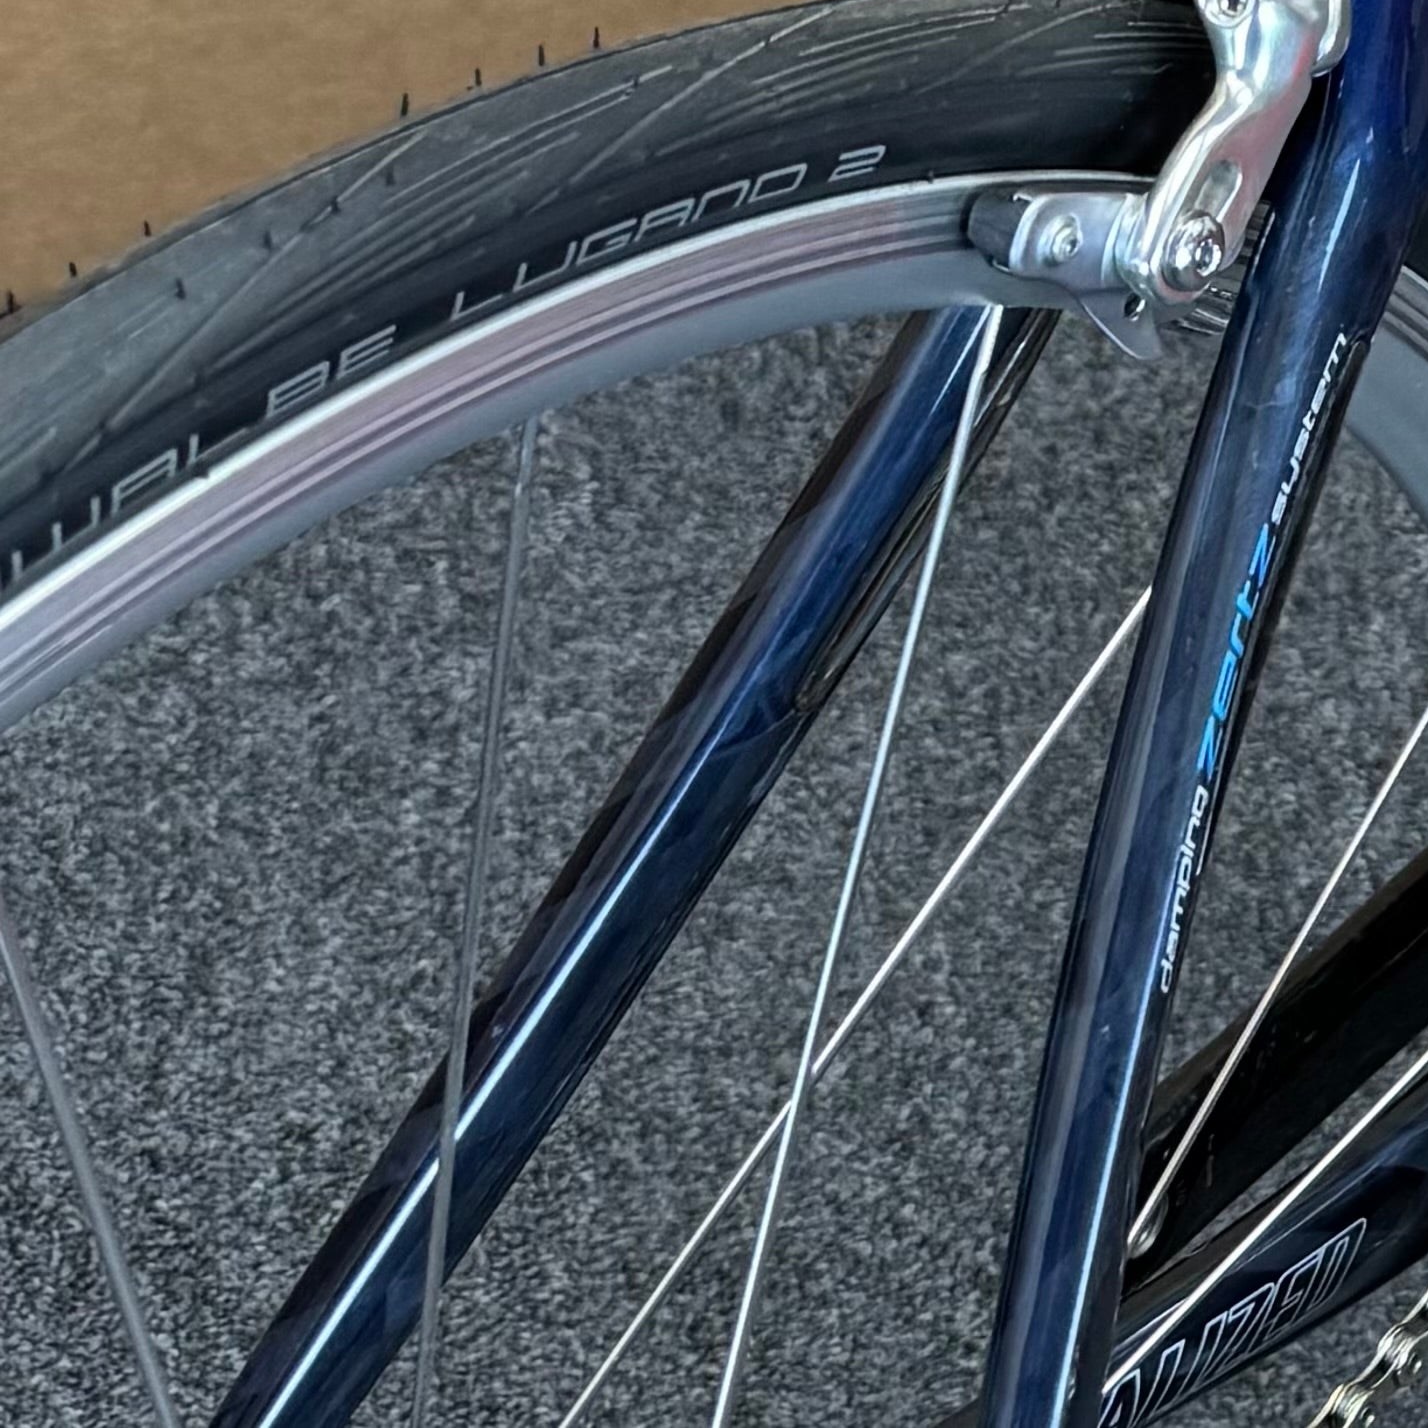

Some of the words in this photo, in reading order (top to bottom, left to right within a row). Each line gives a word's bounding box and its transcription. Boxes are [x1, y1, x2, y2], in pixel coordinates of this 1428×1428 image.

[450, 162, 808, 322] LUGANO
[827, 144, 887, 183] 2
[1194, 523, 1272, 782] zertz
[1270, 330, 1348, 527] system
